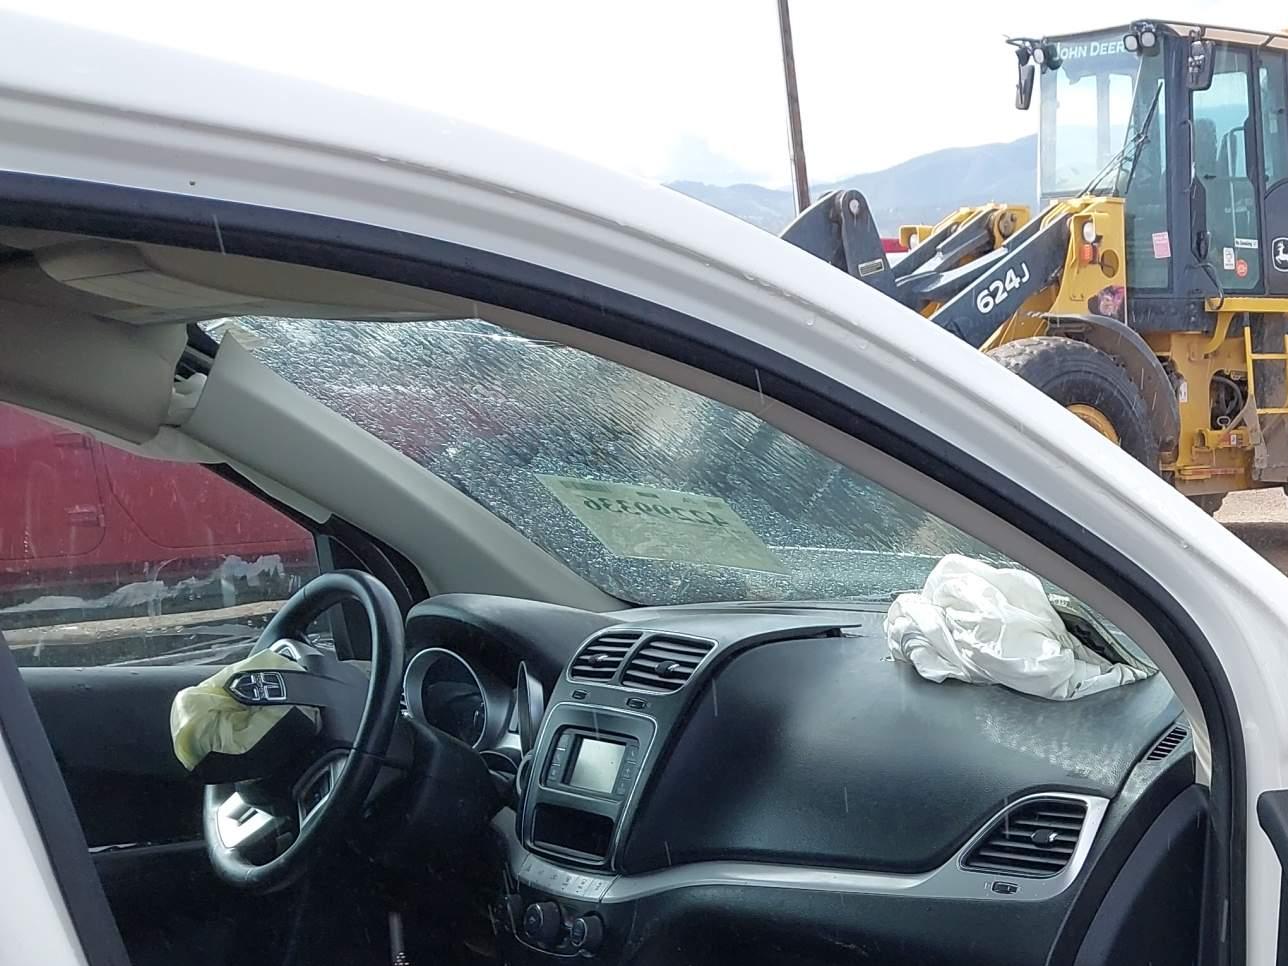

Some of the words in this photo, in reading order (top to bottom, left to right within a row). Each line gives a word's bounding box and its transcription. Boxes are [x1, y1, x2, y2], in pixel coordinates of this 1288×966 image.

[1053, 42, 1088, 60] JOHN
[1090, 41, 1126, 57] DEER
[976, 262, 1031, 314] 624J
